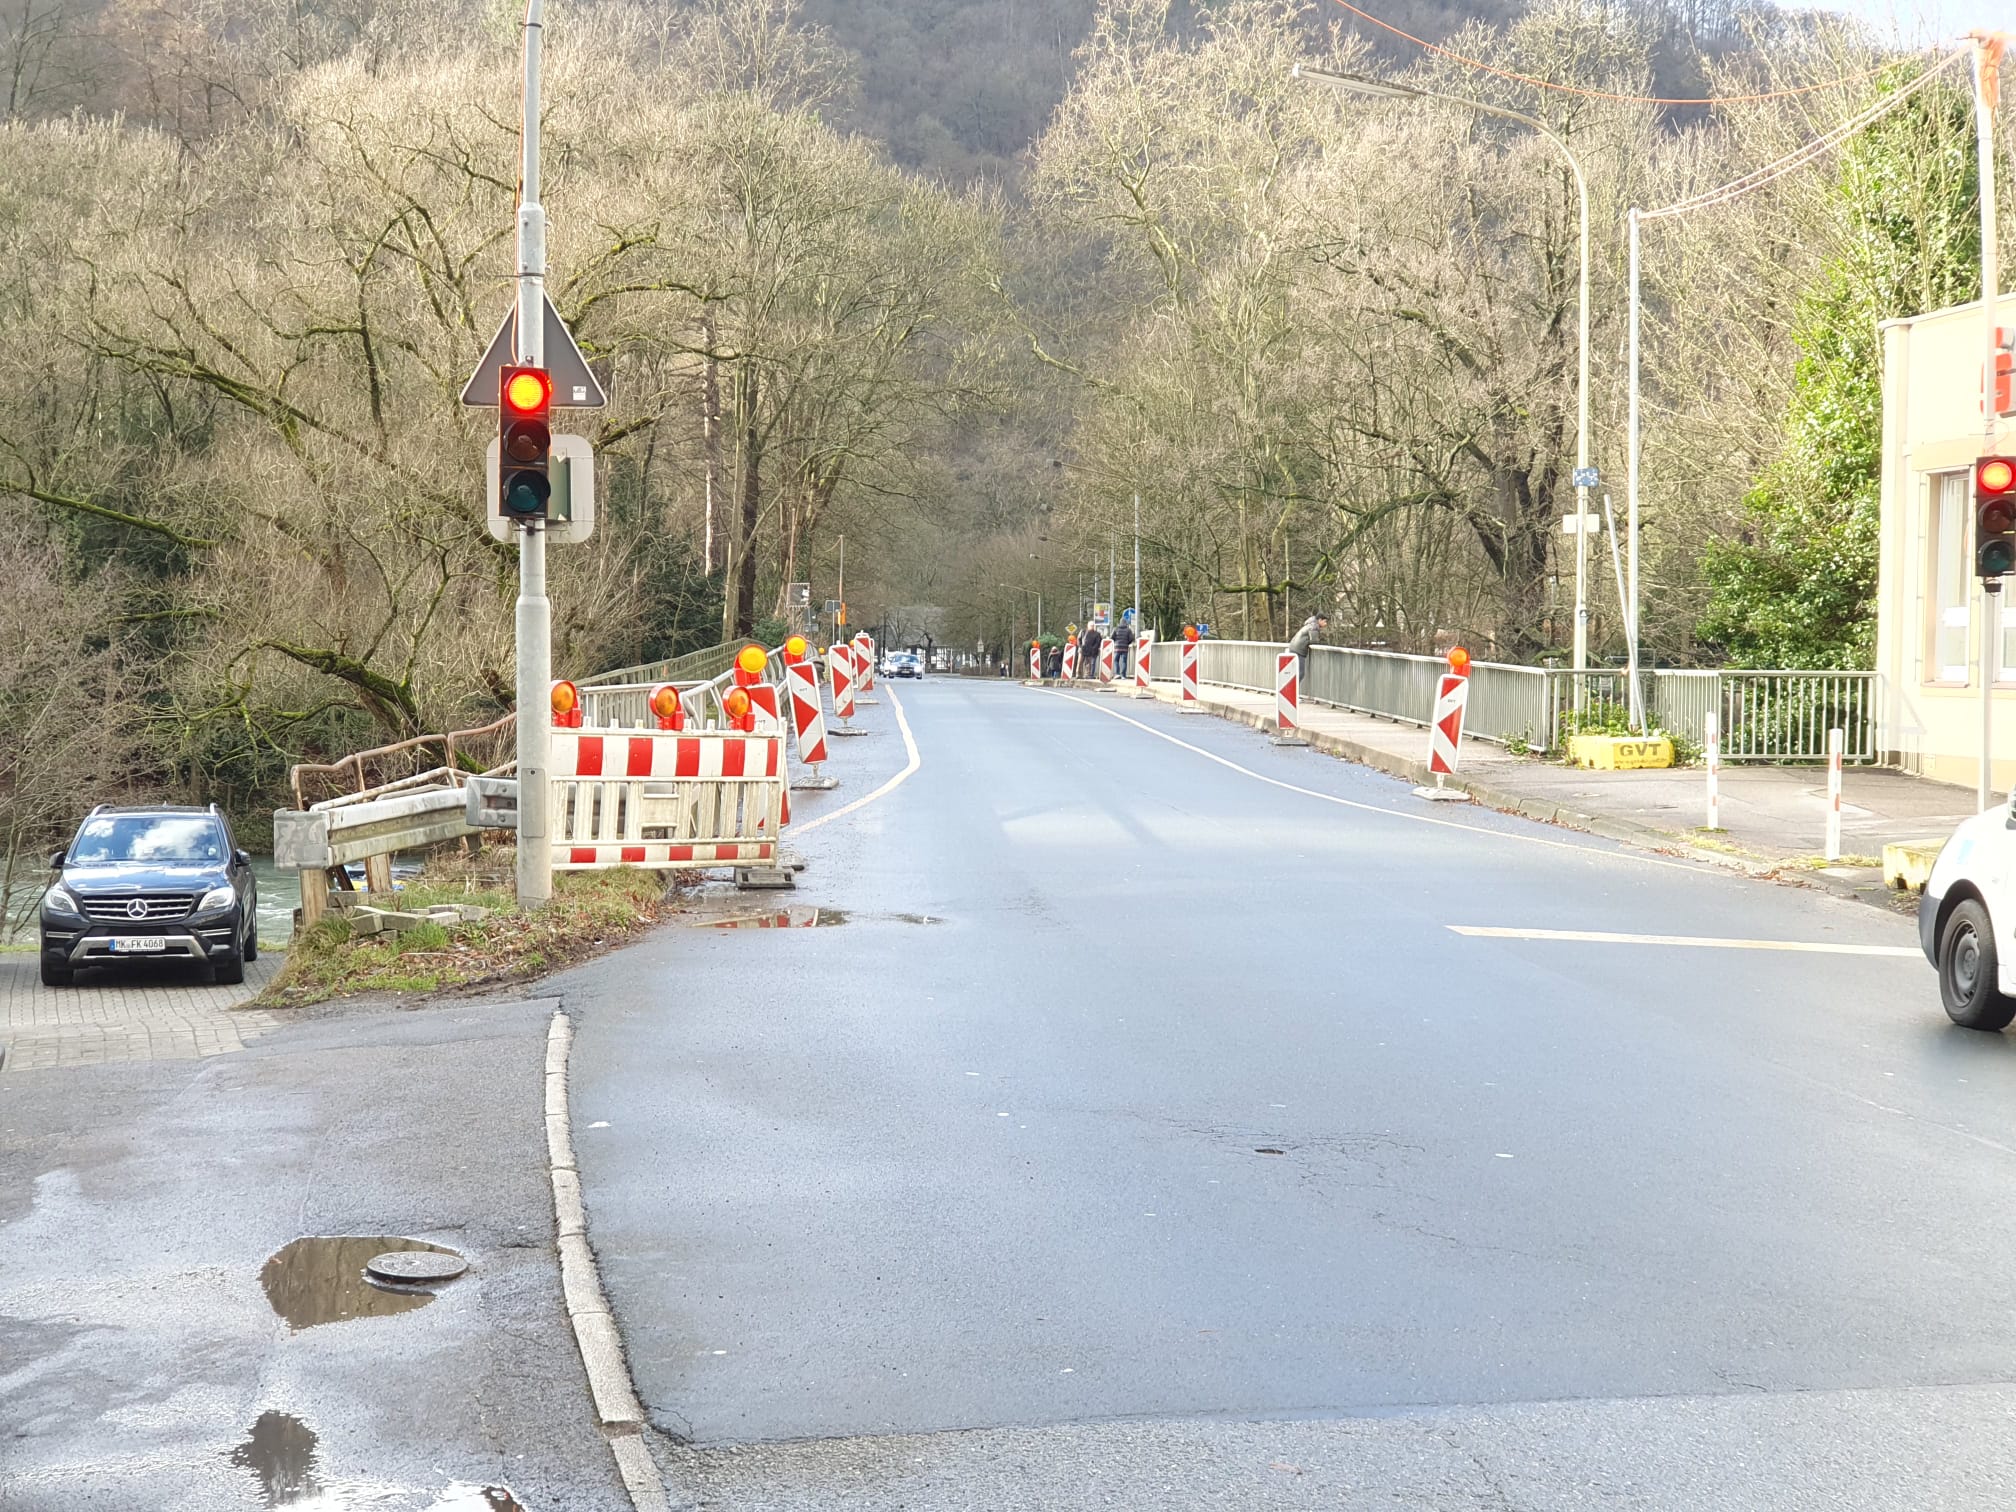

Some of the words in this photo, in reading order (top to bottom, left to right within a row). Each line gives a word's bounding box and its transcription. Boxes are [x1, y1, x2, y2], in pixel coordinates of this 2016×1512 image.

[1620, 743, 1661, 756] GVT
[131, 939, 142, 948] FK
[143, 939, 163, 948] 4068
